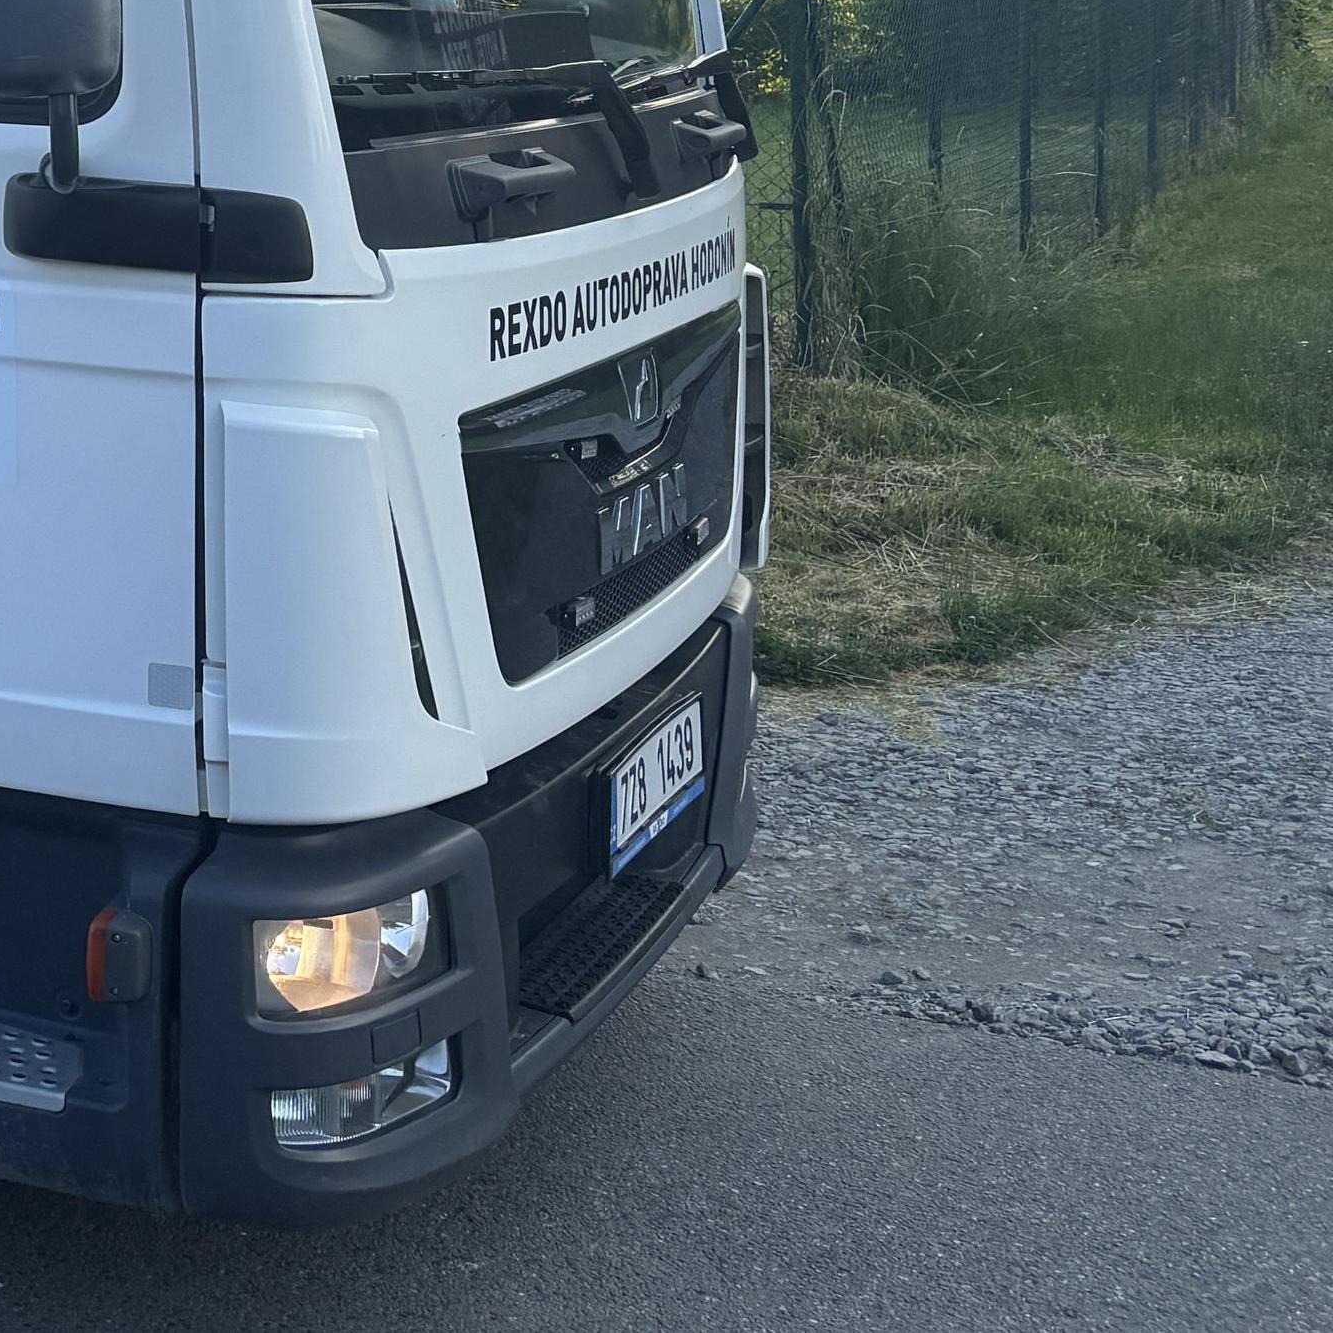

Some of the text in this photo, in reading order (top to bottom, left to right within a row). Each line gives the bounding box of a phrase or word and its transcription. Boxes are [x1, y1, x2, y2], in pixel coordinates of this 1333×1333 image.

[490, 215, 735, 362] REXDO AUTODOPRAVA HODONÍN
[621, 757, 647, 835] 7Z8
[657, 716, 693, 795] 1439
